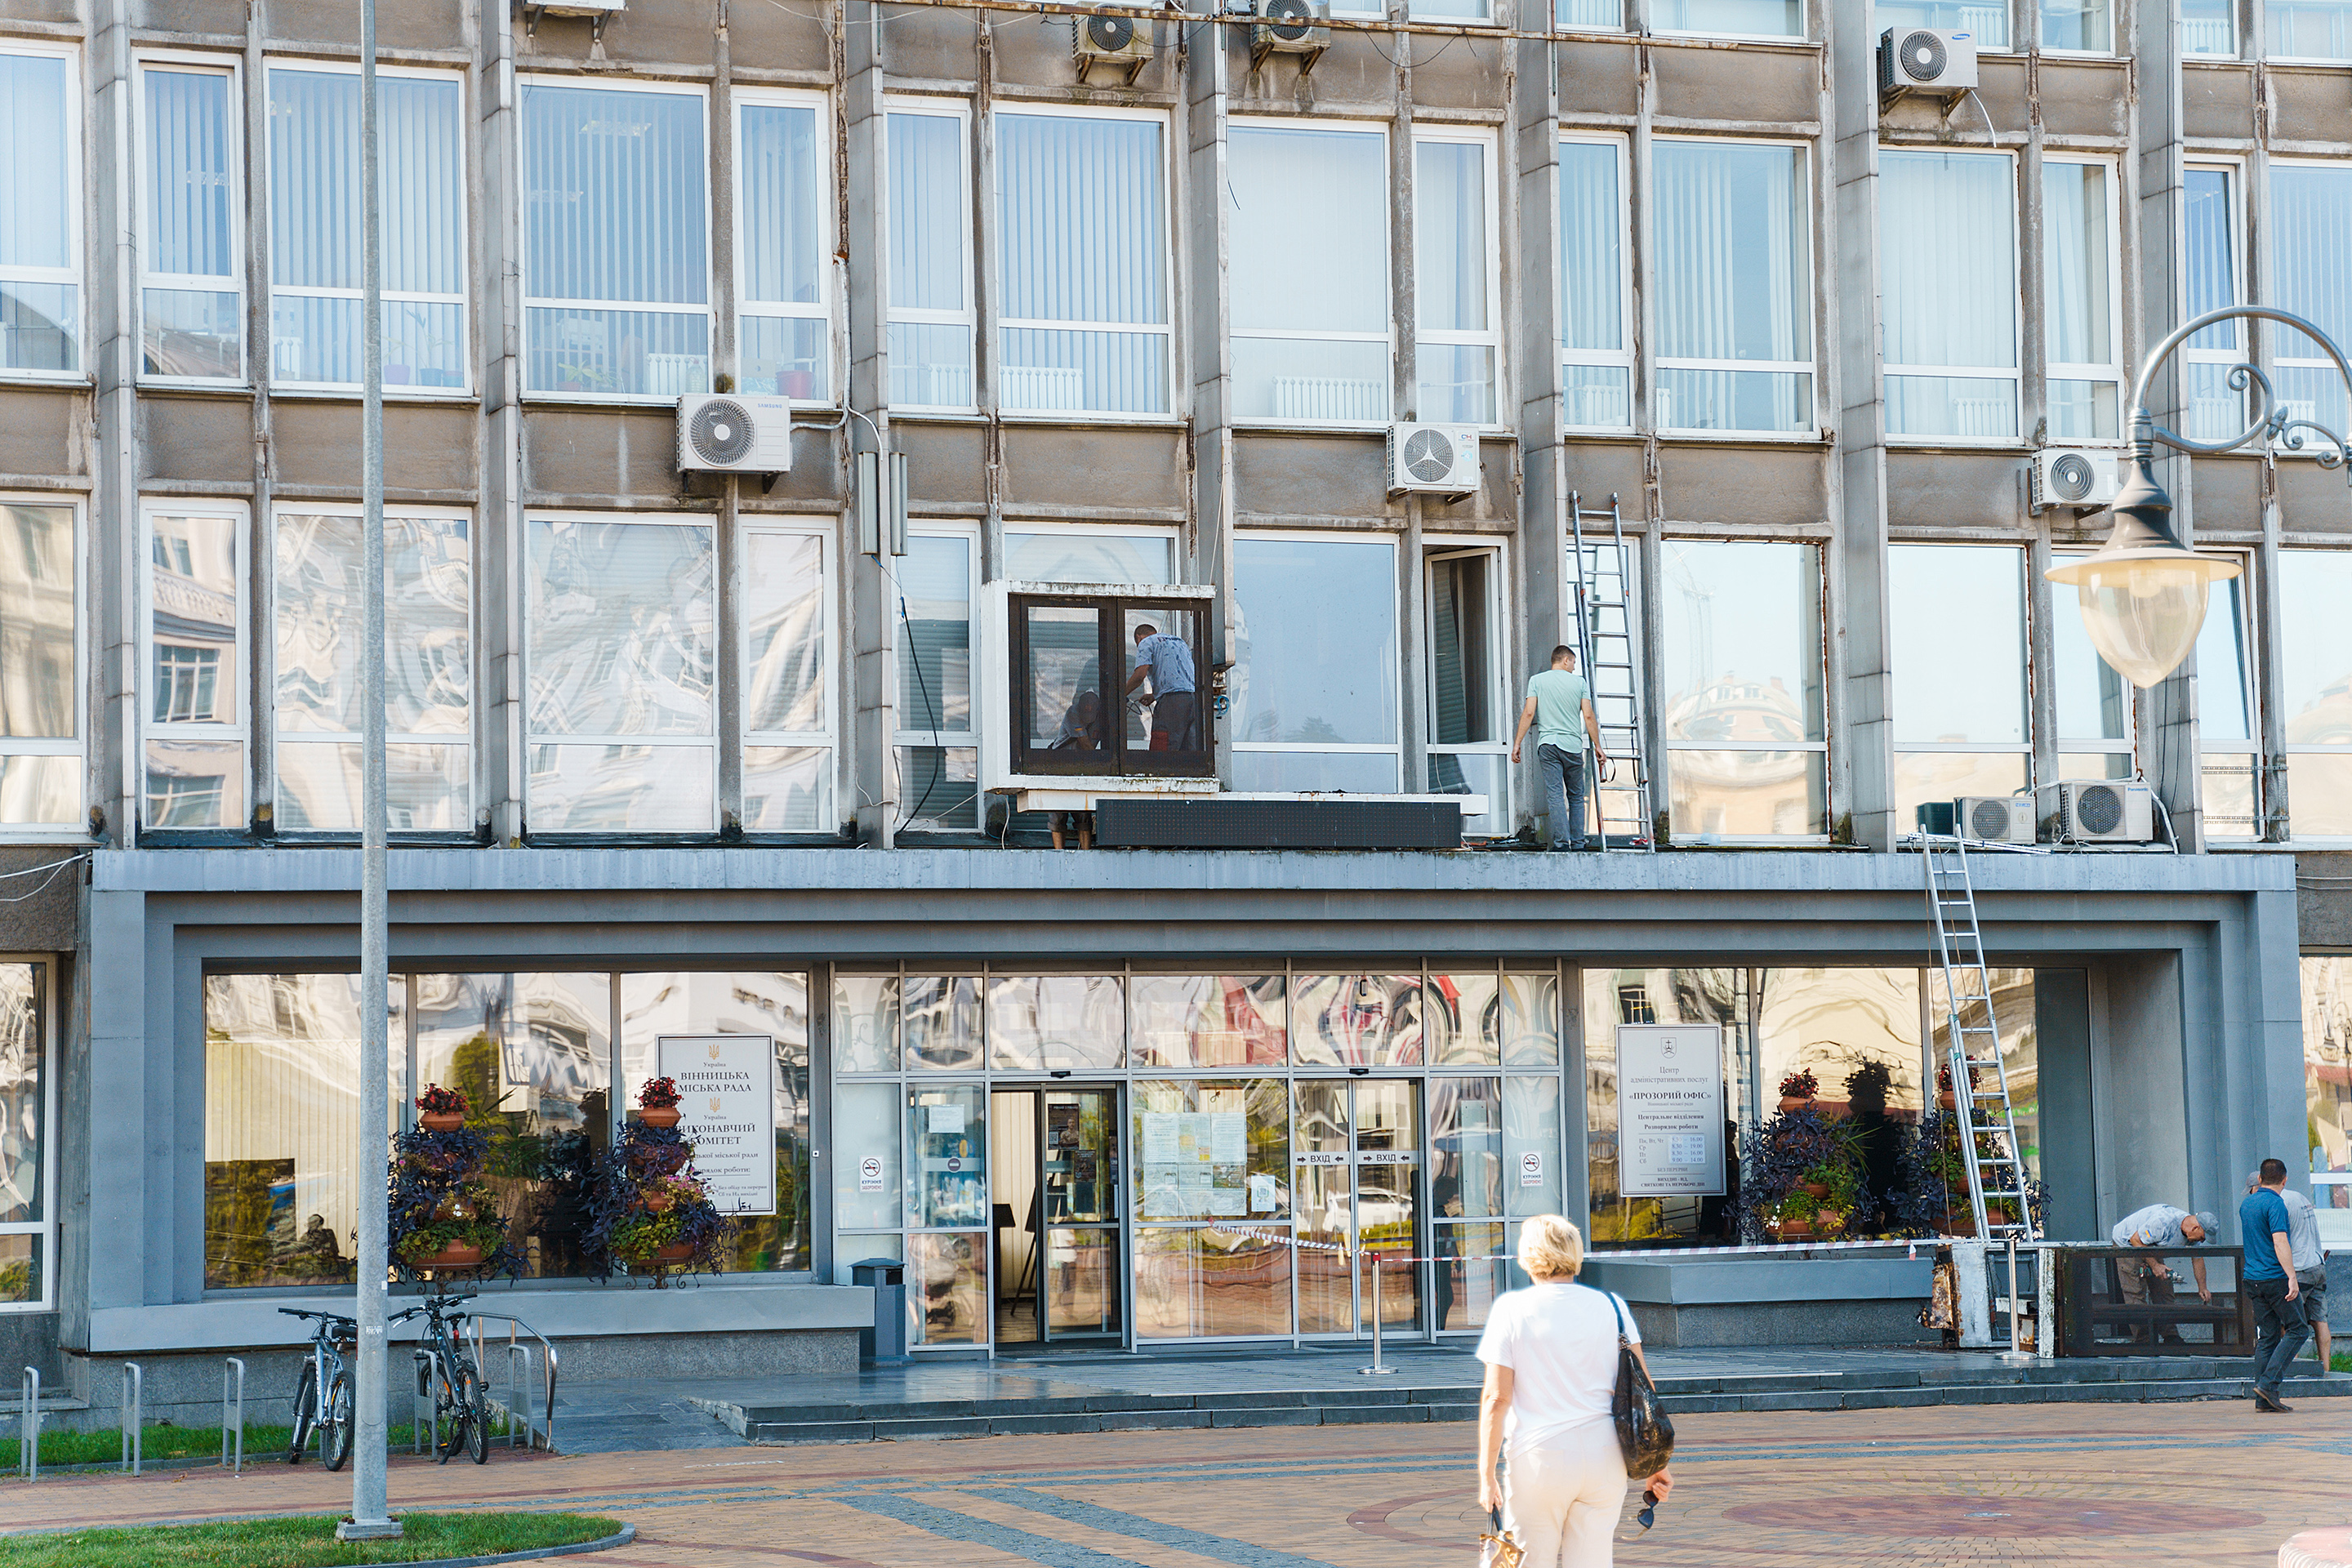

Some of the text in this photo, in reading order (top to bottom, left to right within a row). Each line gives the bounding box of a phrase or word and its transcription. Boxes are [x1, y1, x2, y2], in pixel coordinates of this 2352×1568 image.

[1659, 1067, 1680, 1075] Центр
[680, 1071, 750, 1080] ВІННИЦЬКА
[1630, 1076, 1686, 1085] адміністративних
[679, 1084, 751, 1093] МІСЬКА РАДА
[1629, 1091, 1682, 1099] «ПРОЗОРИЙ
[1310, 1155, 1330, 1163] ВХІД
[1376, 1154, 1396, 1162] ВХІД
